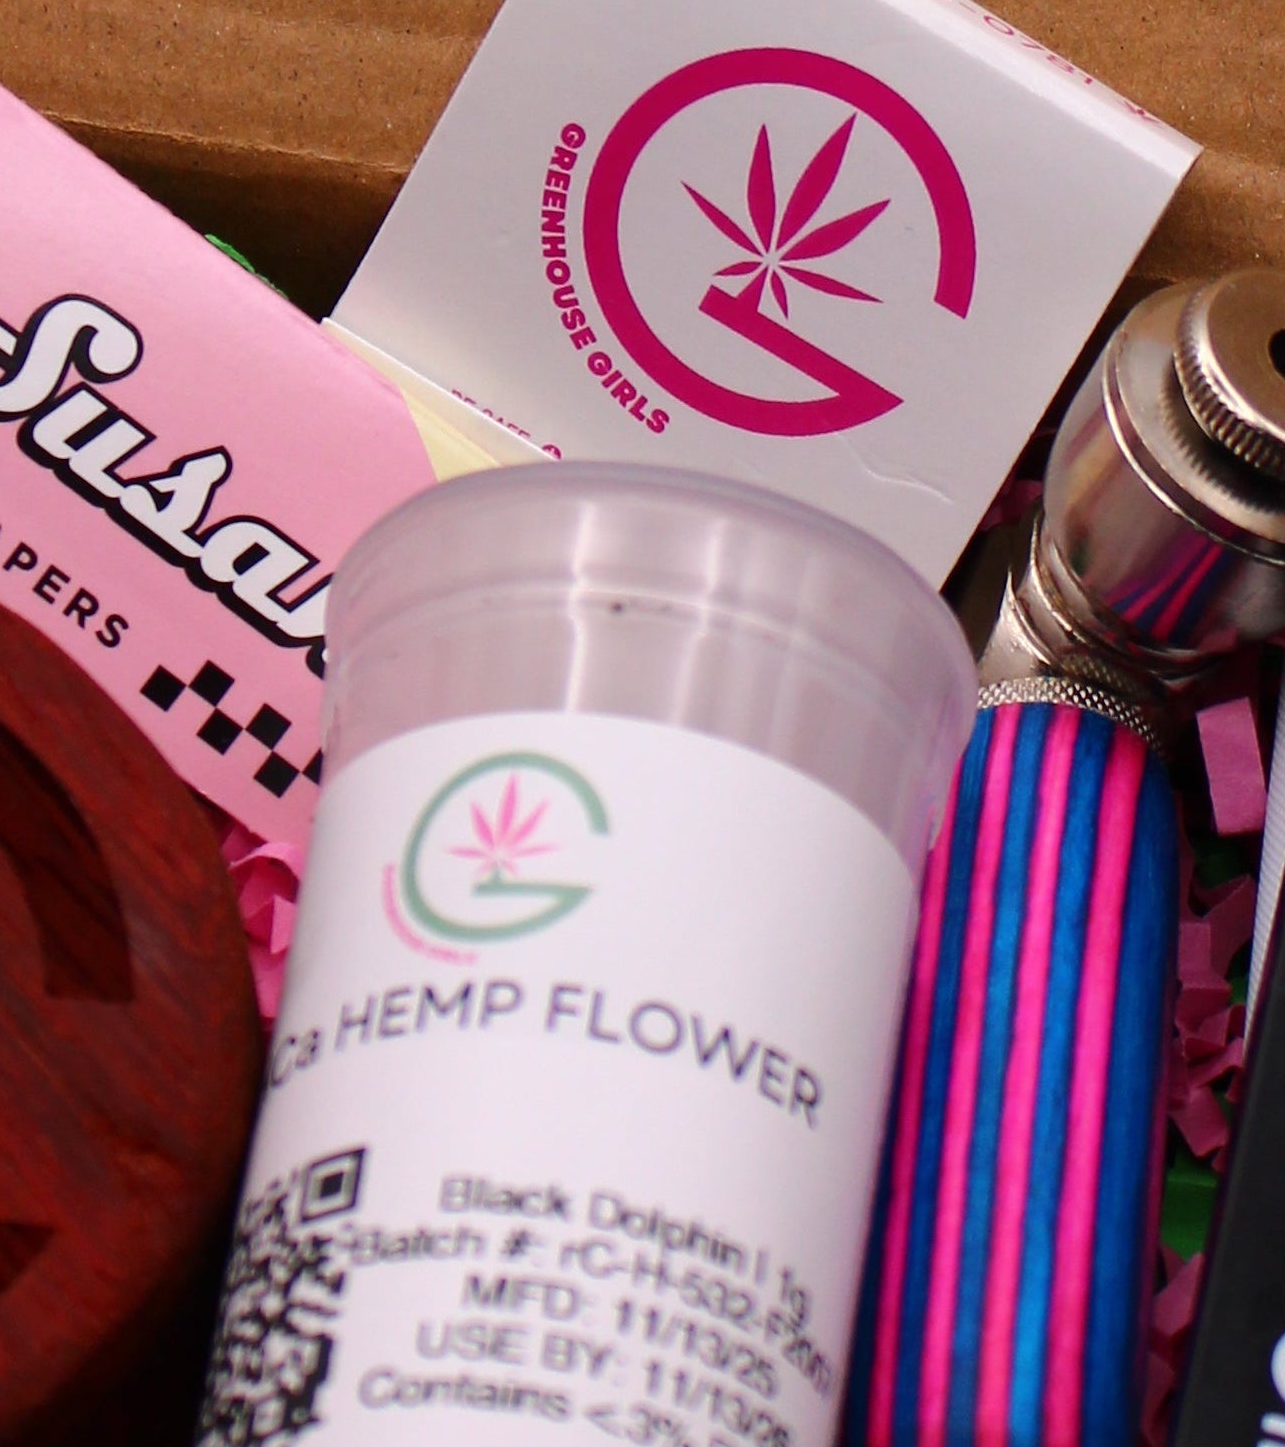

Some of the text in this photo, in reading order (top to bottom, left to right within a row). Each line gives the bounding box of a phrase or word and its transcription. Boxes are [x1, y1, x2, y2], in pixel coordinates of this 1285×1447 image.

[541, 123, 669, 434] GREENHOUSE GIRLS
[334, 978, 523, 1051] HEMP
[545, 982, 822, 1128] FLOWER
[352, 1227, 487, 1265] Batch
[441, 1172, 571, 1219] Black
[588, 1191, 747, 1274] Dolphin
[780, 1266, 806, 1328] 1g
[416, 1321, 529, 1366] USE
[616, 1298, 777, 1399] 11/13/25
[359, 1366, 571, 1424] Contains
